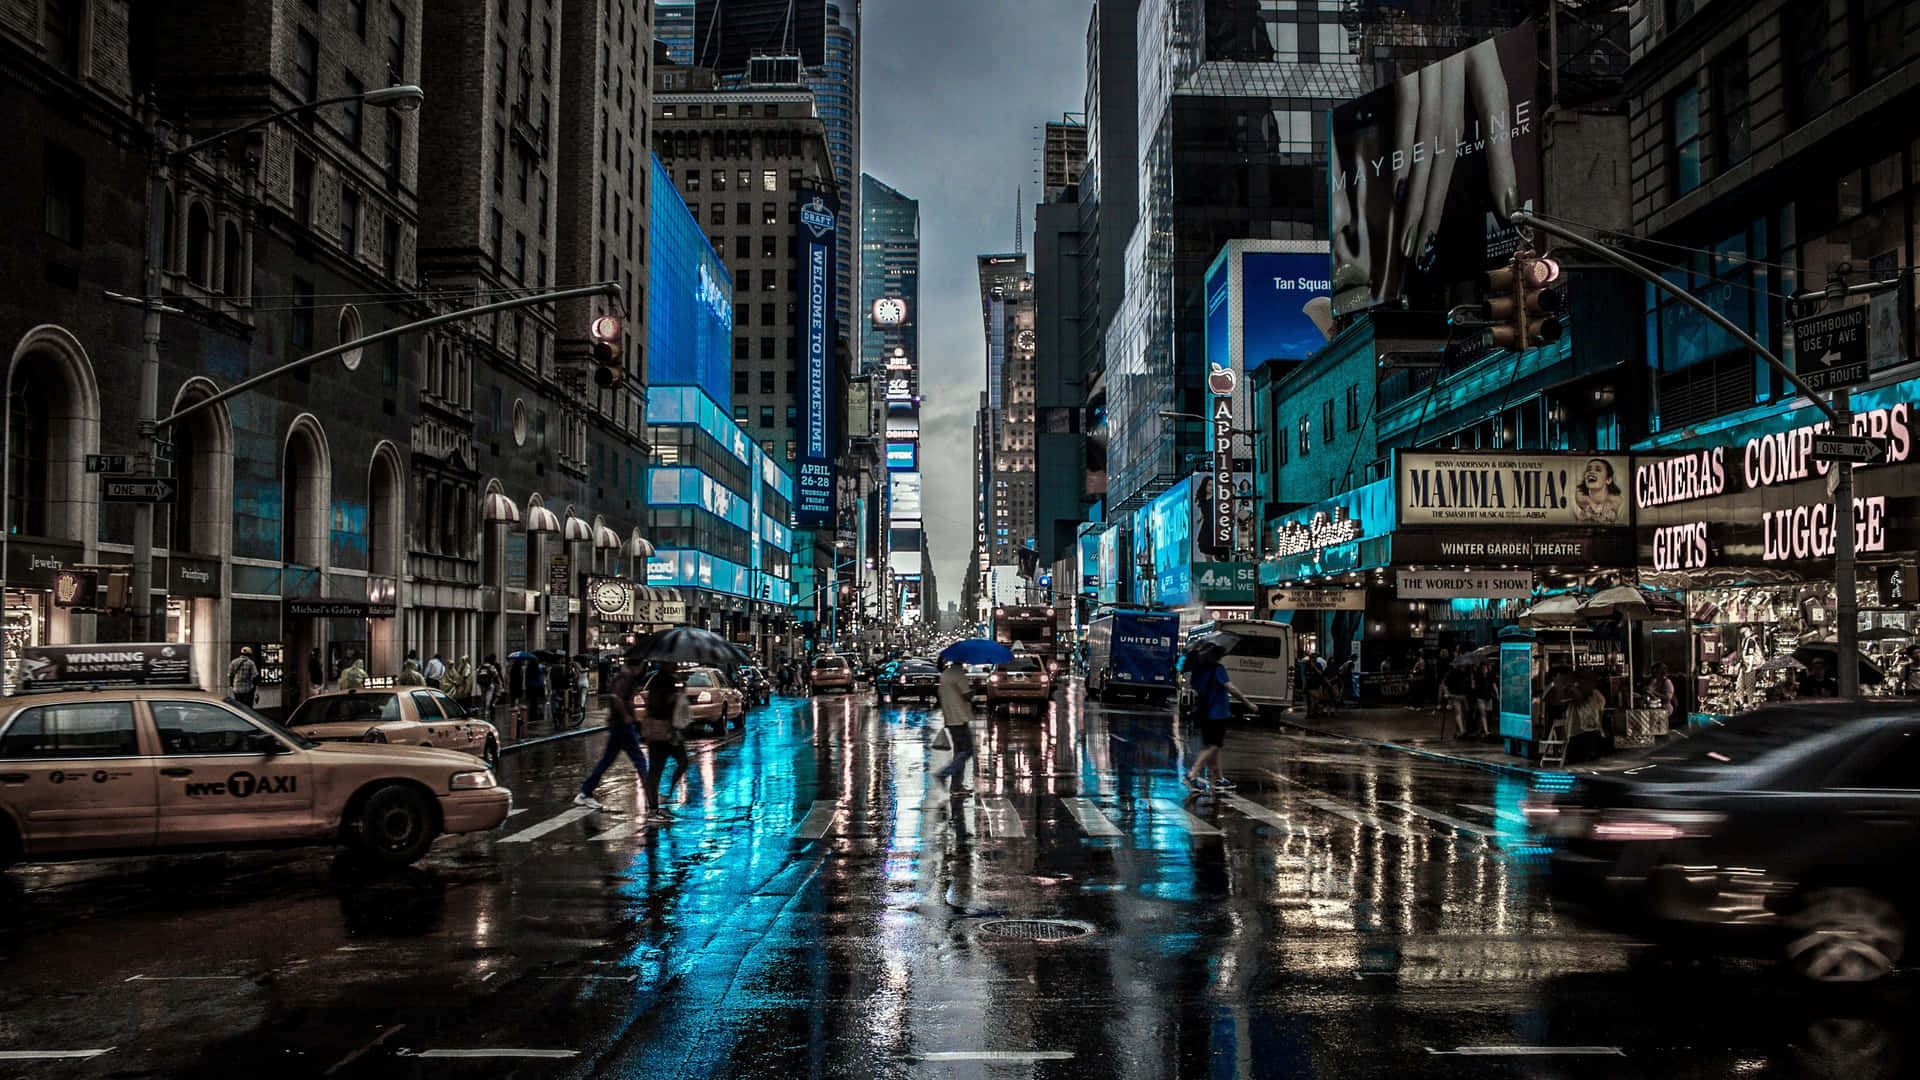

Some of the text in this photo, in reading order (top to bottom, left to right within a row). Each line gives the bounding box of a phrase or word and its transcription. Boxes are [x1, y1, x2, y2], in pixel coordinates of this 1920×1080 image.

[1332, 100, 1532, 192] MAYBELLINE
[1455, 124, 1531, 158] NEW YORK
[803, 210, 833, 226] DRAFT
[1273, 277, 1296, 290] Tan
[1798, 311, 1862, 338] SOUTHBOUND
[1803, 328, 1857, 352] USE 7 AVE
[812, 250, 824, 452] WELCOME TO PRIMETIME
[1830, 365, 1863, 385] ROUTE
[1744, 402, 1911, 489] COMPUERS
[1822, 443, 1876, 456] ONE WAY
[88, 455, 97, 471] W
[100, 456, 110, 472] 51
[801, 463, 830, 476] APRIL
[801, 476, 830, 487] 26-28
[1636, 445, 1725, 509] CAMERAS
[113, 485, 166, 495] ONE WAY
[1409, 469, 1567, 509] MAMMA MIA!
[1479, 511, 1504, 519] MUSICAL
[1441, 543, 1581, 555] WINTER GARDEN THEATRE
[1652, 520, 1708, 572] GIFTS
[29, 553, 64, 571] Jewelry
[1200, 568, 1215, 586] 4
[1403, 578, 1529, 590] THE WORLD'S #1 SHOW!
[290, 604, 331, 615] Michael's
[331, 605, 361, 616] Gallery
[1119, 635, 1159, 646] UNITED
[65, 652, 145, 663] WINNING
[186, 771, 296, 799] NYC TAXI
